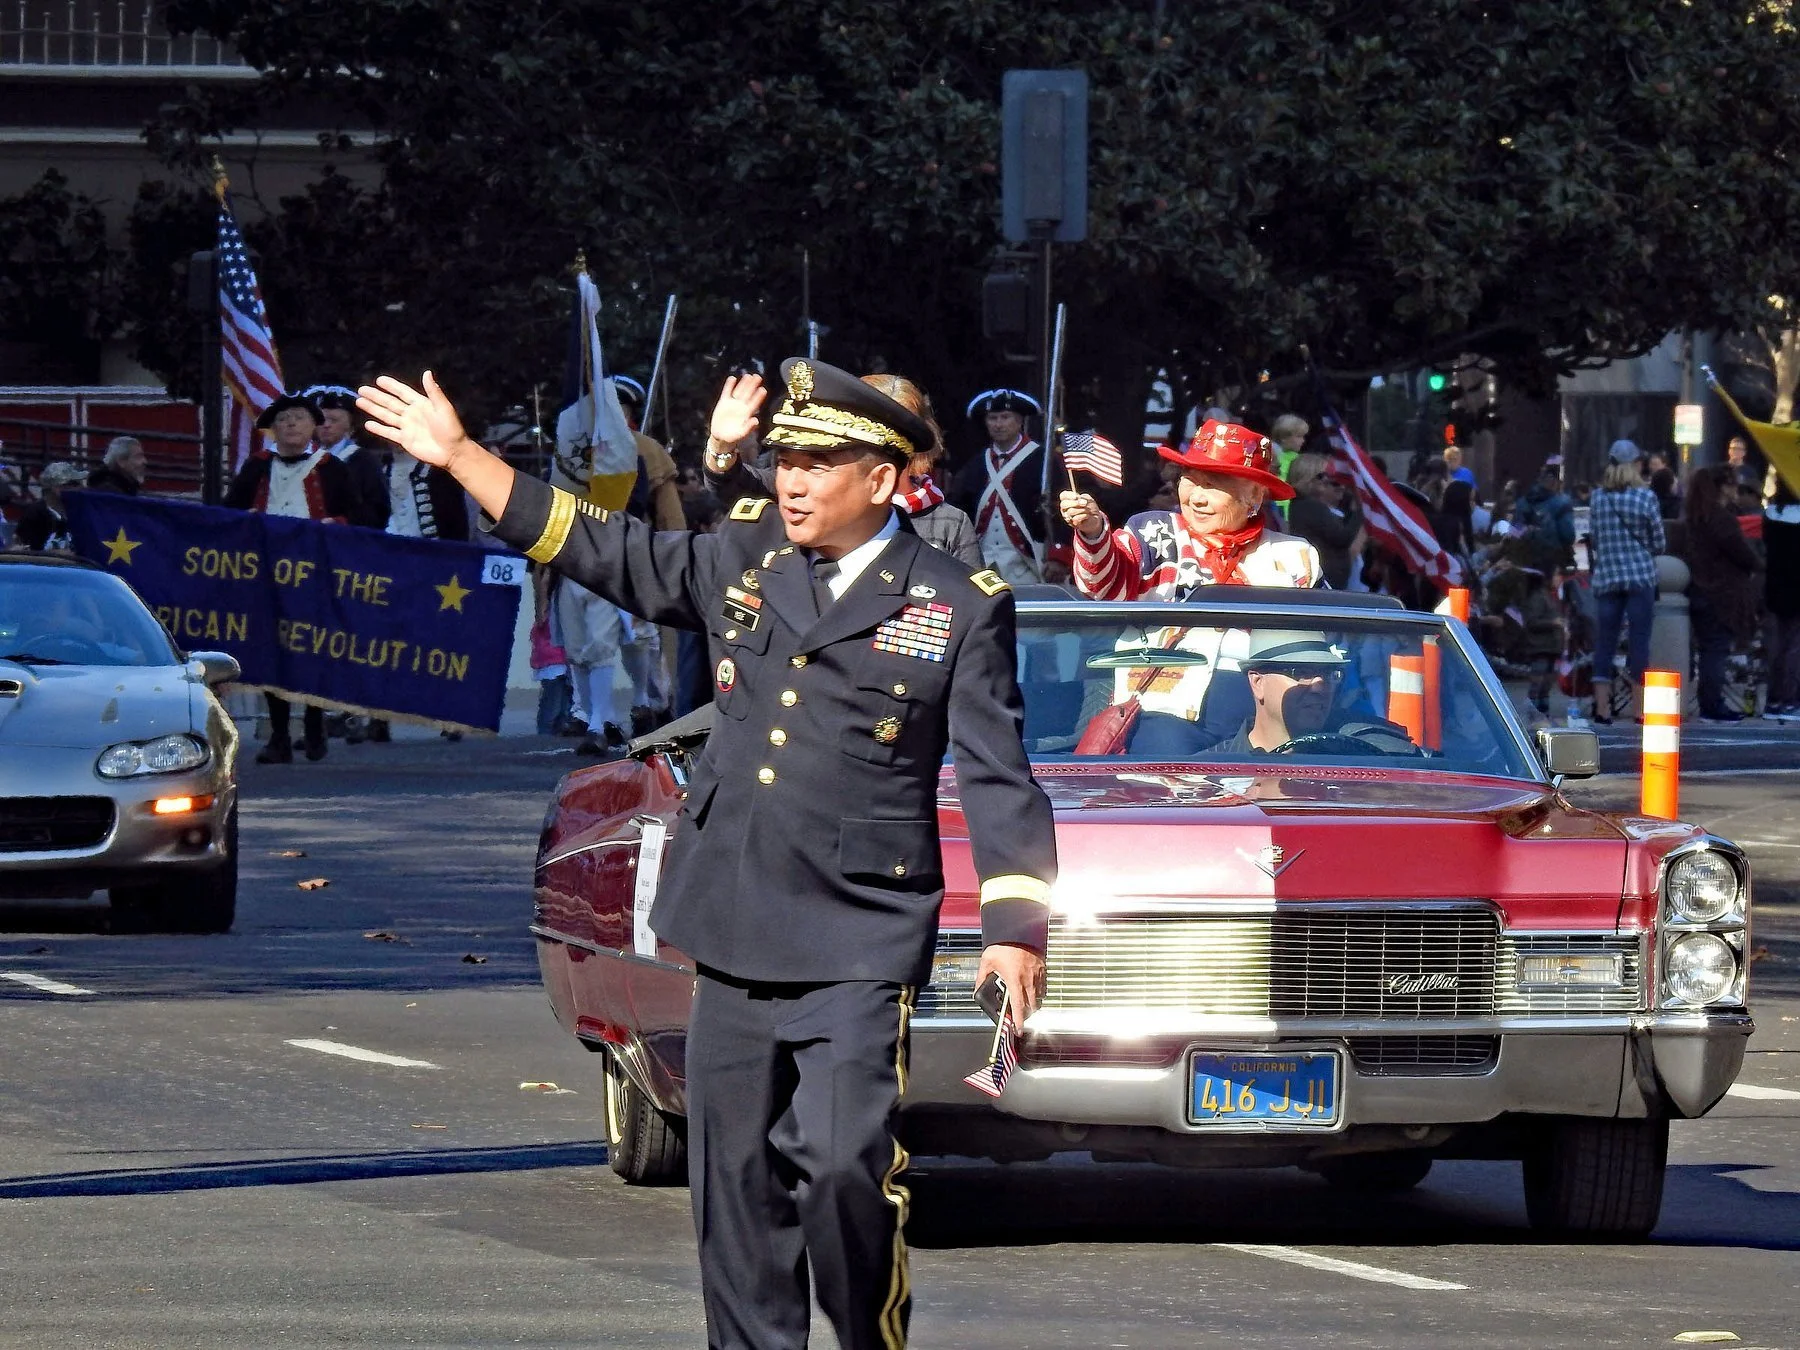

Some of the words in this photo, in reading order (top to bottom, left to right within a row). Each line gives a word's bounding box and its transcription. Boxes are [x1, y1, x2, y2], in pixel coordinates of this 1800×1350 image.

[183, 546, 259, 579] SONS
[274, 559, 315, 587] OF
[332, 568, 393, 606] THE
[490, 563, 514, 582] 08
[279, 618, 470, 682] REVOLUTION
[1389, 973, 1459, 994] Cadillac
[1231, 1062, 1297, 1073] CALIFORNIA
[1201, 1078, 1256, 1113] 416
